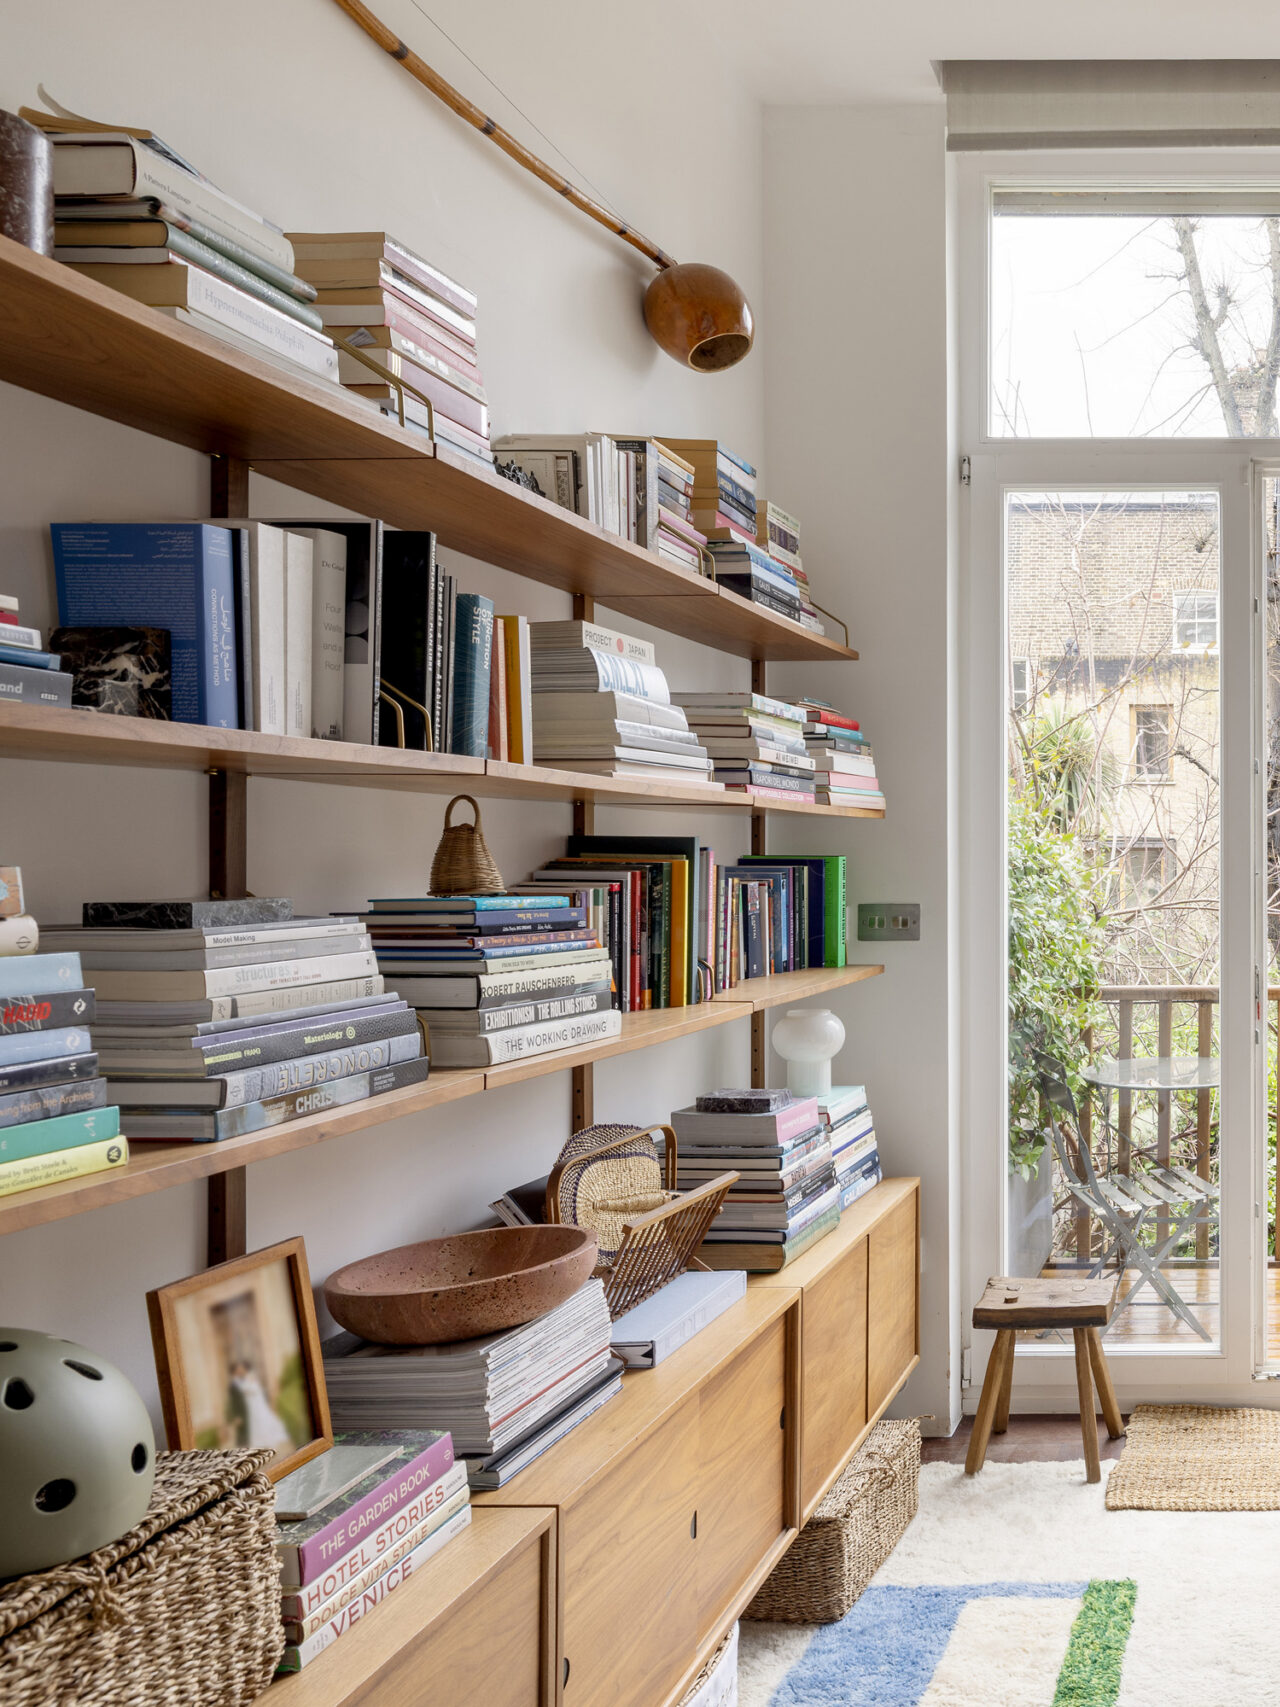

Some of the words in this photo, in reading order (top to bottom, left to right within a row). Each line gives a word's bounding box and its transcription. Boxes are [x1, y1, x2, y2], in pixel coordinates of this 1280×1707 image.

[211, 588, 219, 642] CONNECTIONS
[325, 603, 342, 614] Four
[438, 581, 446, 627] Towards
[481, 608, 488, 625] OF
[471, 606, 481, 645] STYLE
[483, 610, 492, 670] FUNCTION
[322, 643, 337, 652] and
[585, 629, 613, 647] PROJECT
[627, 643, 647, 658] JAPAN
[324, 661, 341, 672] Roof
[213, 936, 232, 945] Model
[233, 934, 256, 944] Making
[235, 965, 291, 983] structures
[482, 983, 513, 998] ROBERT
[515, 975, 575, 993] RAUSCHENBERG
[4, 1002, 51, 1025] HADID
[485, 1005, 535, 1030] EXHIBITIONISM
[537, 1003, 550, 1020] THE
[550, 999, 575, 1018] ROLLING
[575, 995, 598, 1013] STONES
[304, 1030, 343, 1044] Materiology
[505, 1039, 523, 1053] THE
[526, 1029, 568, 1048] WORKING
[570, 1021, 607, 1039] DRAWING
[278, 1047, 384, 1092] CONCRETE
[20, 1101, 41, 1113] from
[43, 1098, 58, 1108] the
[60, 1091, 95, 1104] Archives
[319, 1529, 346, 1560] THE
[348, 1487, 398, 1538] GARDEN
[399, 1463, 431, 1498] BOOK
[307, 1549, 372, 1612] HOTEL
[376, 1485, 445, 1552] STORIES
[310, 1584, 357, 1634] DOLCE
[361, 1560, 389, 1590] VITA
[392, 1524, 429, 1563] STYLE
[330, 1556, 413, 1638] VENICE
